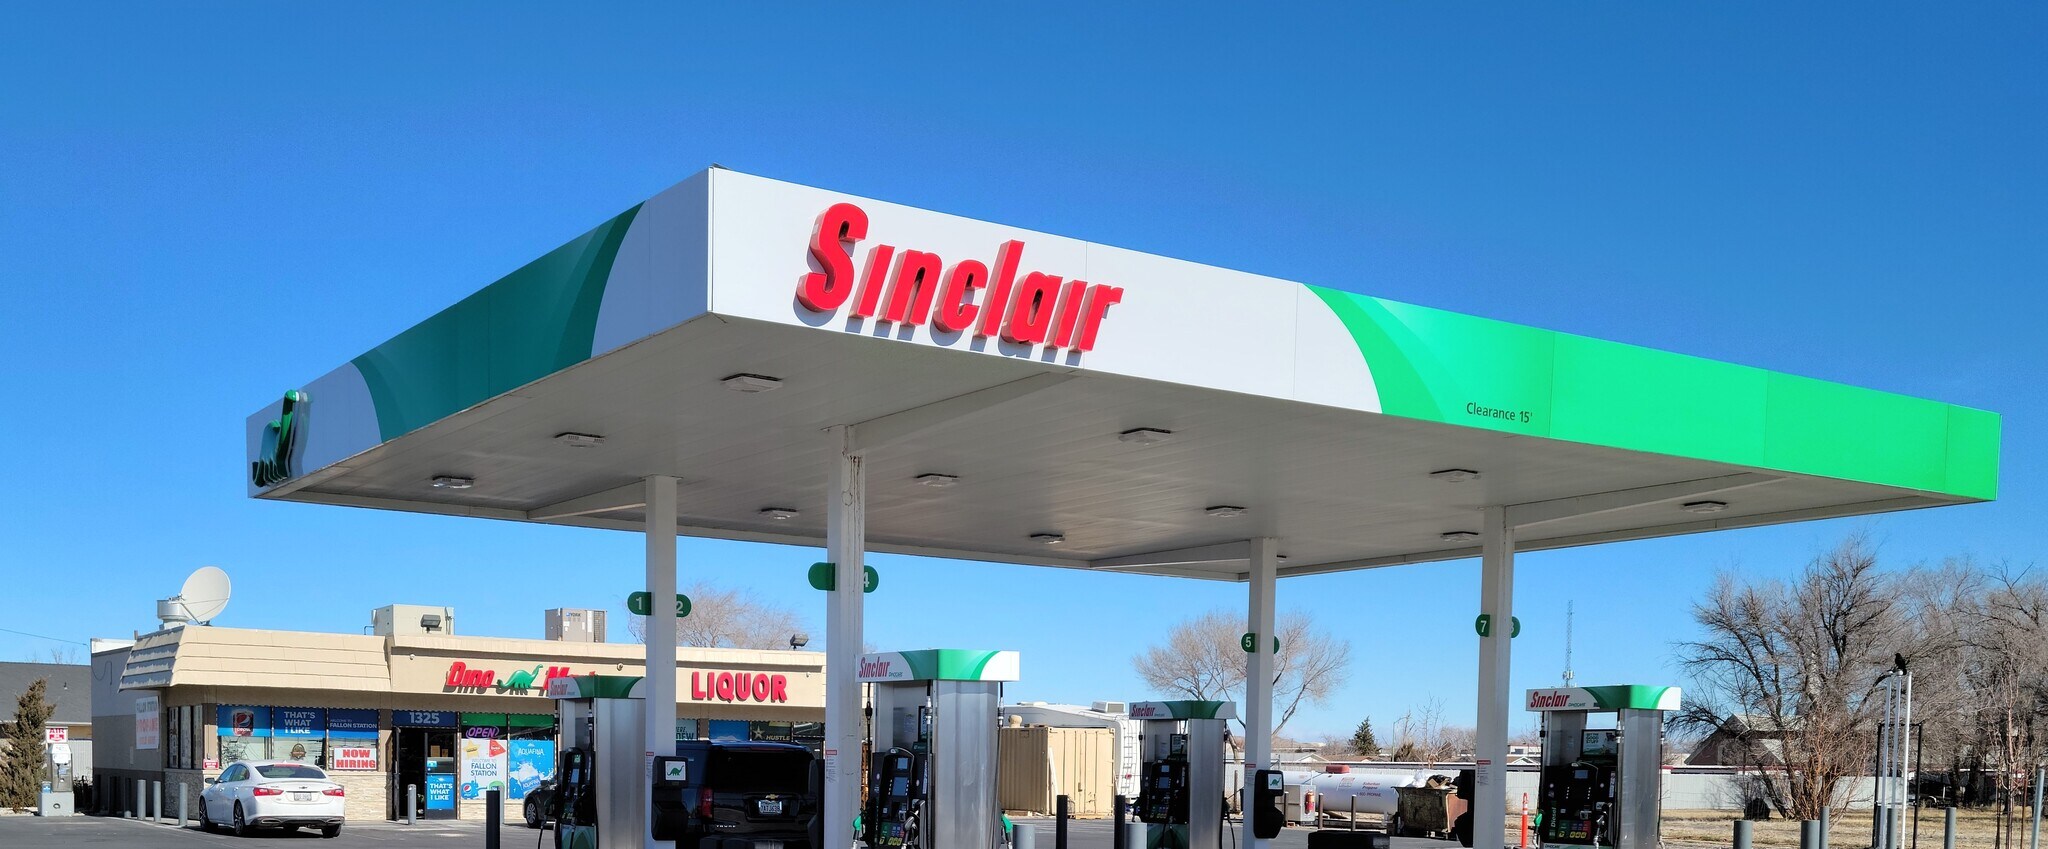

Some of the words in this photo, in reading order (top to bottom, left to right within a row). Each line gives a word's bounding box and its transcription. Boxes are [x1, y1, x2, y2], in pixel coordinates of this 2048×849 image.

[797, 202, 1124, 352] Sinclair
[1466, 402, 1516, 421] Clearance
[1519, 411, 1533, 423] 15'
[635, 596, 643, 610] 1
[676, 600, 684, 614] 2
[1480, 620, 1487, 633] 7
[1245, 636, 1252, 648] 5
[859, 656, 890, 678] Sinclair
[446, 661, 495, 688] Dino
[693, 671, 787, 703] LIQUOR
[1530, 691, 1570, 708] Sinclair
[284, 711, 316, 719] THAT'S
[1131, 703, 1155, 717] Sinclair
[284, 719, 311, 727] WHAT
[409, 711, 440, 724] 1325
[468, 727, 495, 738] OPEN
[342, 749, 371, 758] NOW
[518, 748, 545, 756] AQUAFINA
[336, 759, 376, 769] HIRING
[471, 762, 497, 770] FALLON
